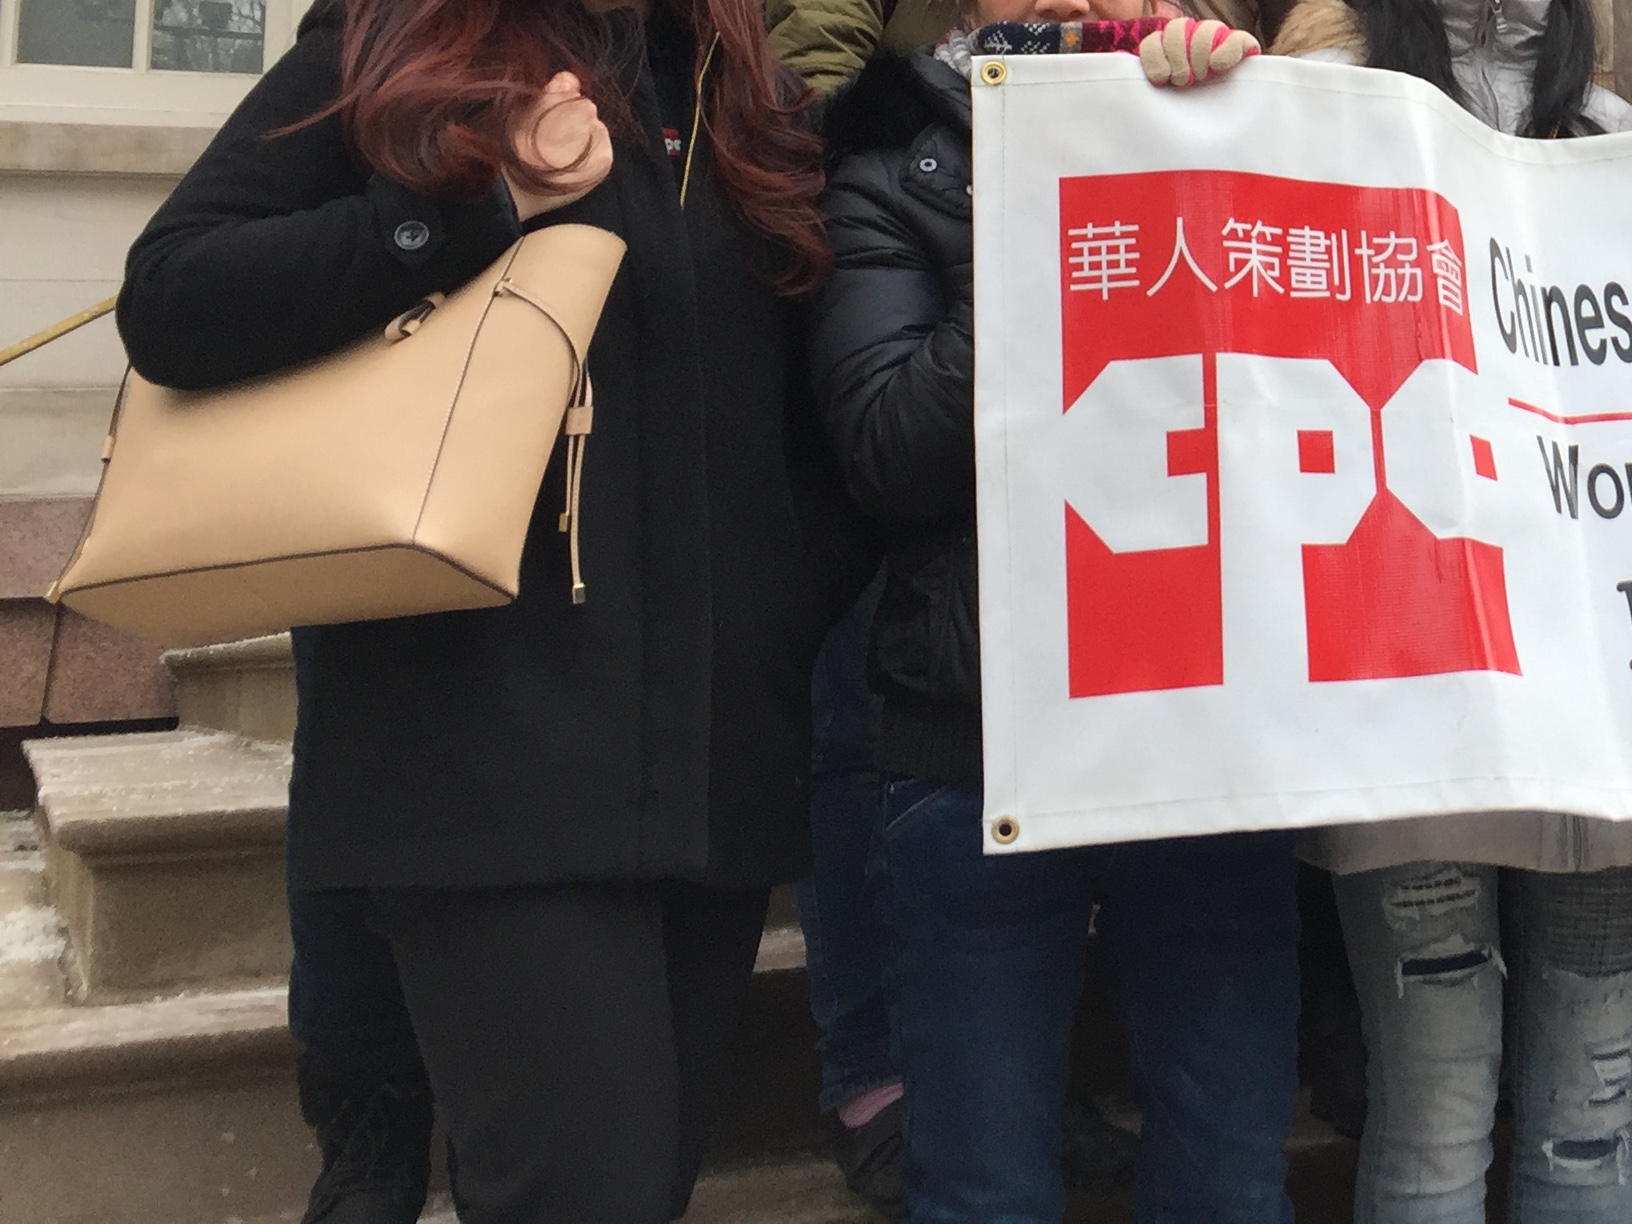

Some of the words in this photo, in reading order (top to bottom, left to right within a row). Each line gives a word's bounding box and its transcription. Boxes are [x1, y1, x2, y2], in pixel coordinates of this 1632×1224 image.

[1067, 216, 1465, 317] 華人策劃協會
